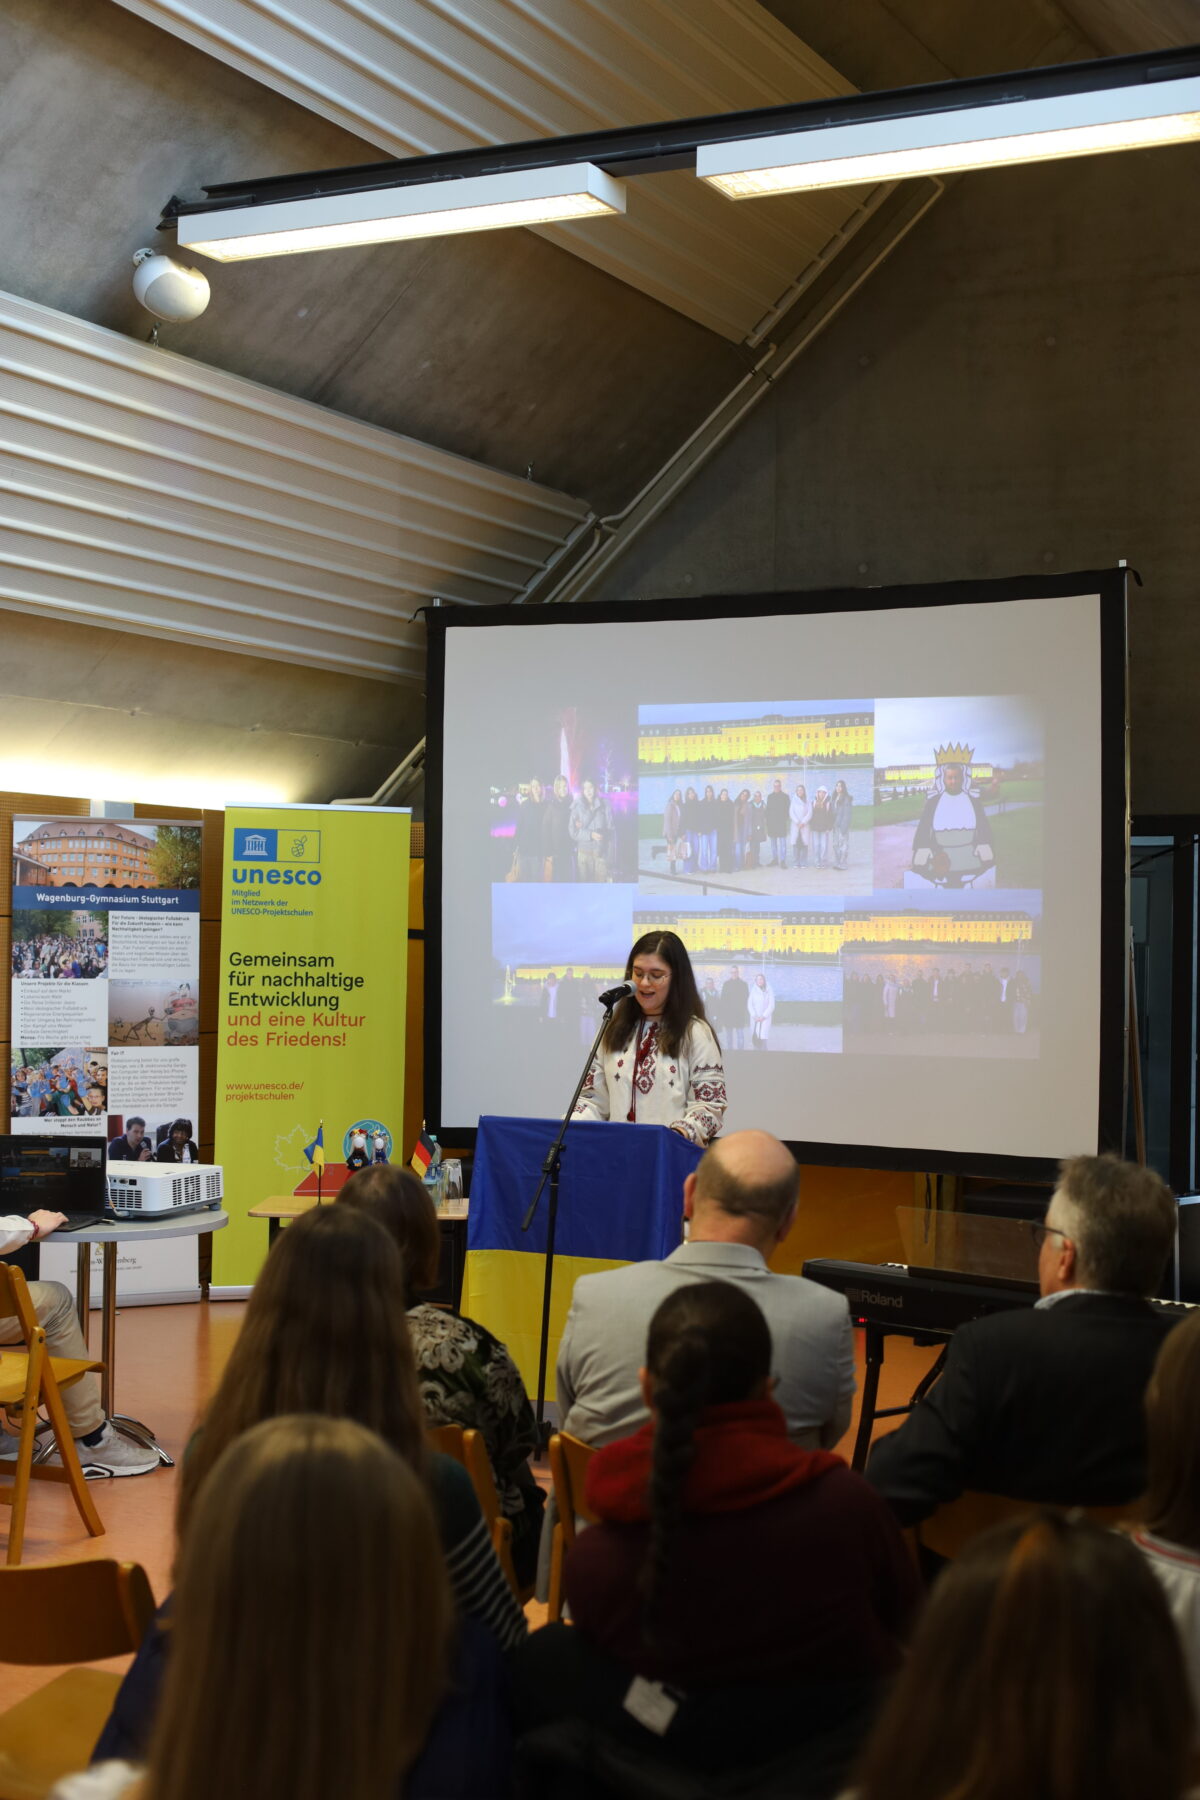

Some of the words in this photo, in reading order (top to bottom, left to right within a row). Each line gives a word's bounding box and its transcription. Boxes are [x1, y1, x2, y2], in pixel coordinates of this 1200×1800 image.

[232, 868, 322, 886] unesco
[36, 893, 139, 904] Wagenburg-Gymnasium
[141, 896, 179, 906] Stuttgart
[232, 890, 260, 898] Mitglied
[242, 898, 274, 906] Netzwerk
[231, 908, 314, 917] UNESCO-Projektschulen
[229, 952, 334, 967] Gemeinsam
[228, 972, 254, 986] für
[262, 972, 364, 991] nachhaltige
[228, 992, 339, 1011] Entwicklung
[227, 1011, 261, 1026] und
[268, 1012, 306, 1027] eine
[313, 1012, 366, 1027] Kultur
[226, 1031, 258, 1046] des
[266, 1032, 346, 1047] Friedens!
[226, 1082, 304, 1090] www.unesco.de/
[225, 1092, 294, 1102] projektschulen
[862, 1290, 903, 1308] Roland
